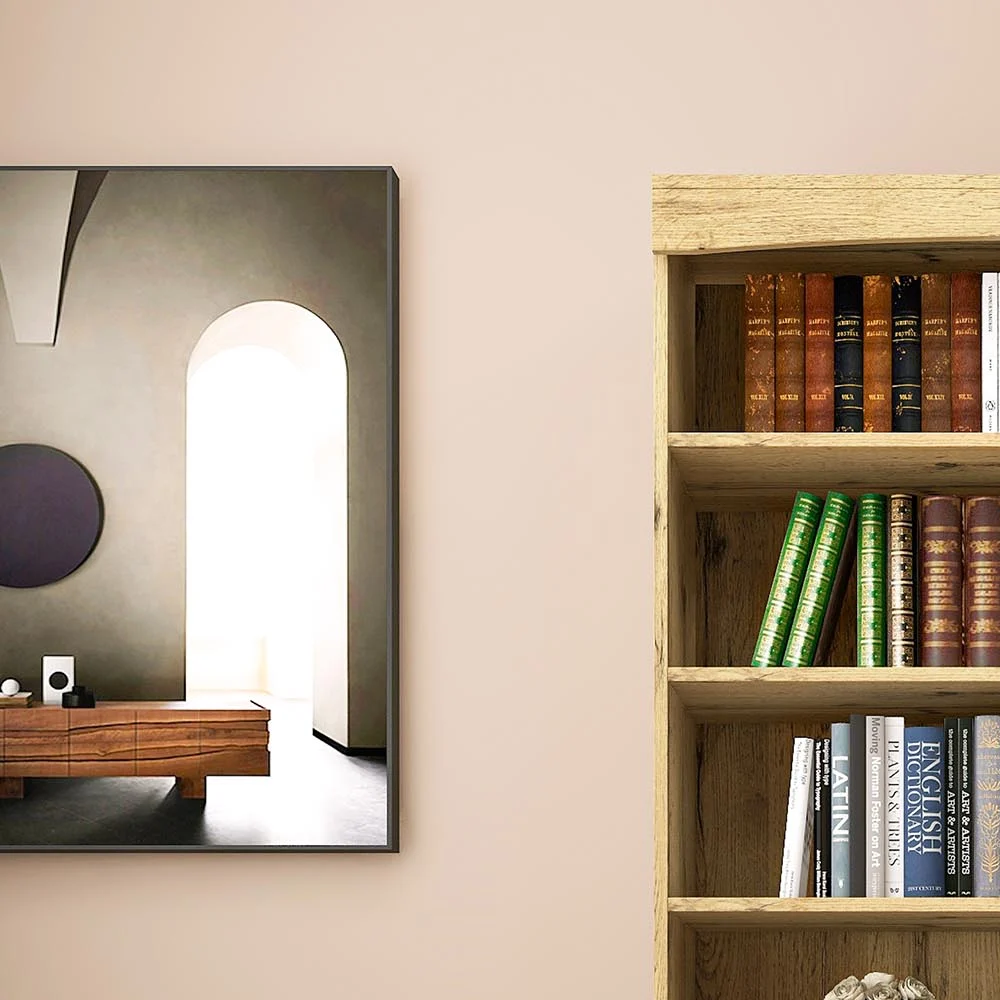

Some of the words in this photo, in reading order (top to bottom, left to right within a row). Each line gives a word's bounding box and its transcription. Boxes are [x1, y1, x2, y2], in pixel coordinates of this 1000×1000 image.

[869, 717, 880, 754] Moving
[871, 757, 881, 798] Norman
[888, 740, 900, 799] PLANTS
[832, 755, 849, 835] LATIN
[888, 801, 900, 813] &
[906, 741, 922, 856] DICTIONARY
[922, 740, 942, 855] ENGLISH
[947, 790, 956, 814] ART
[961, 790, 970, 814] ART
[871, 801, 881, 834] Foster
[947, 816, 956, 826] &
[961, 816, 970, 826] &
[871, 836, 878, 849] on
[871, 851, 881, 868] Art
[888, 815, 900, 867] TREES
[947, 827, 956, 875] ARTISTS
[961, 827, 970, 875] ARTISTS
